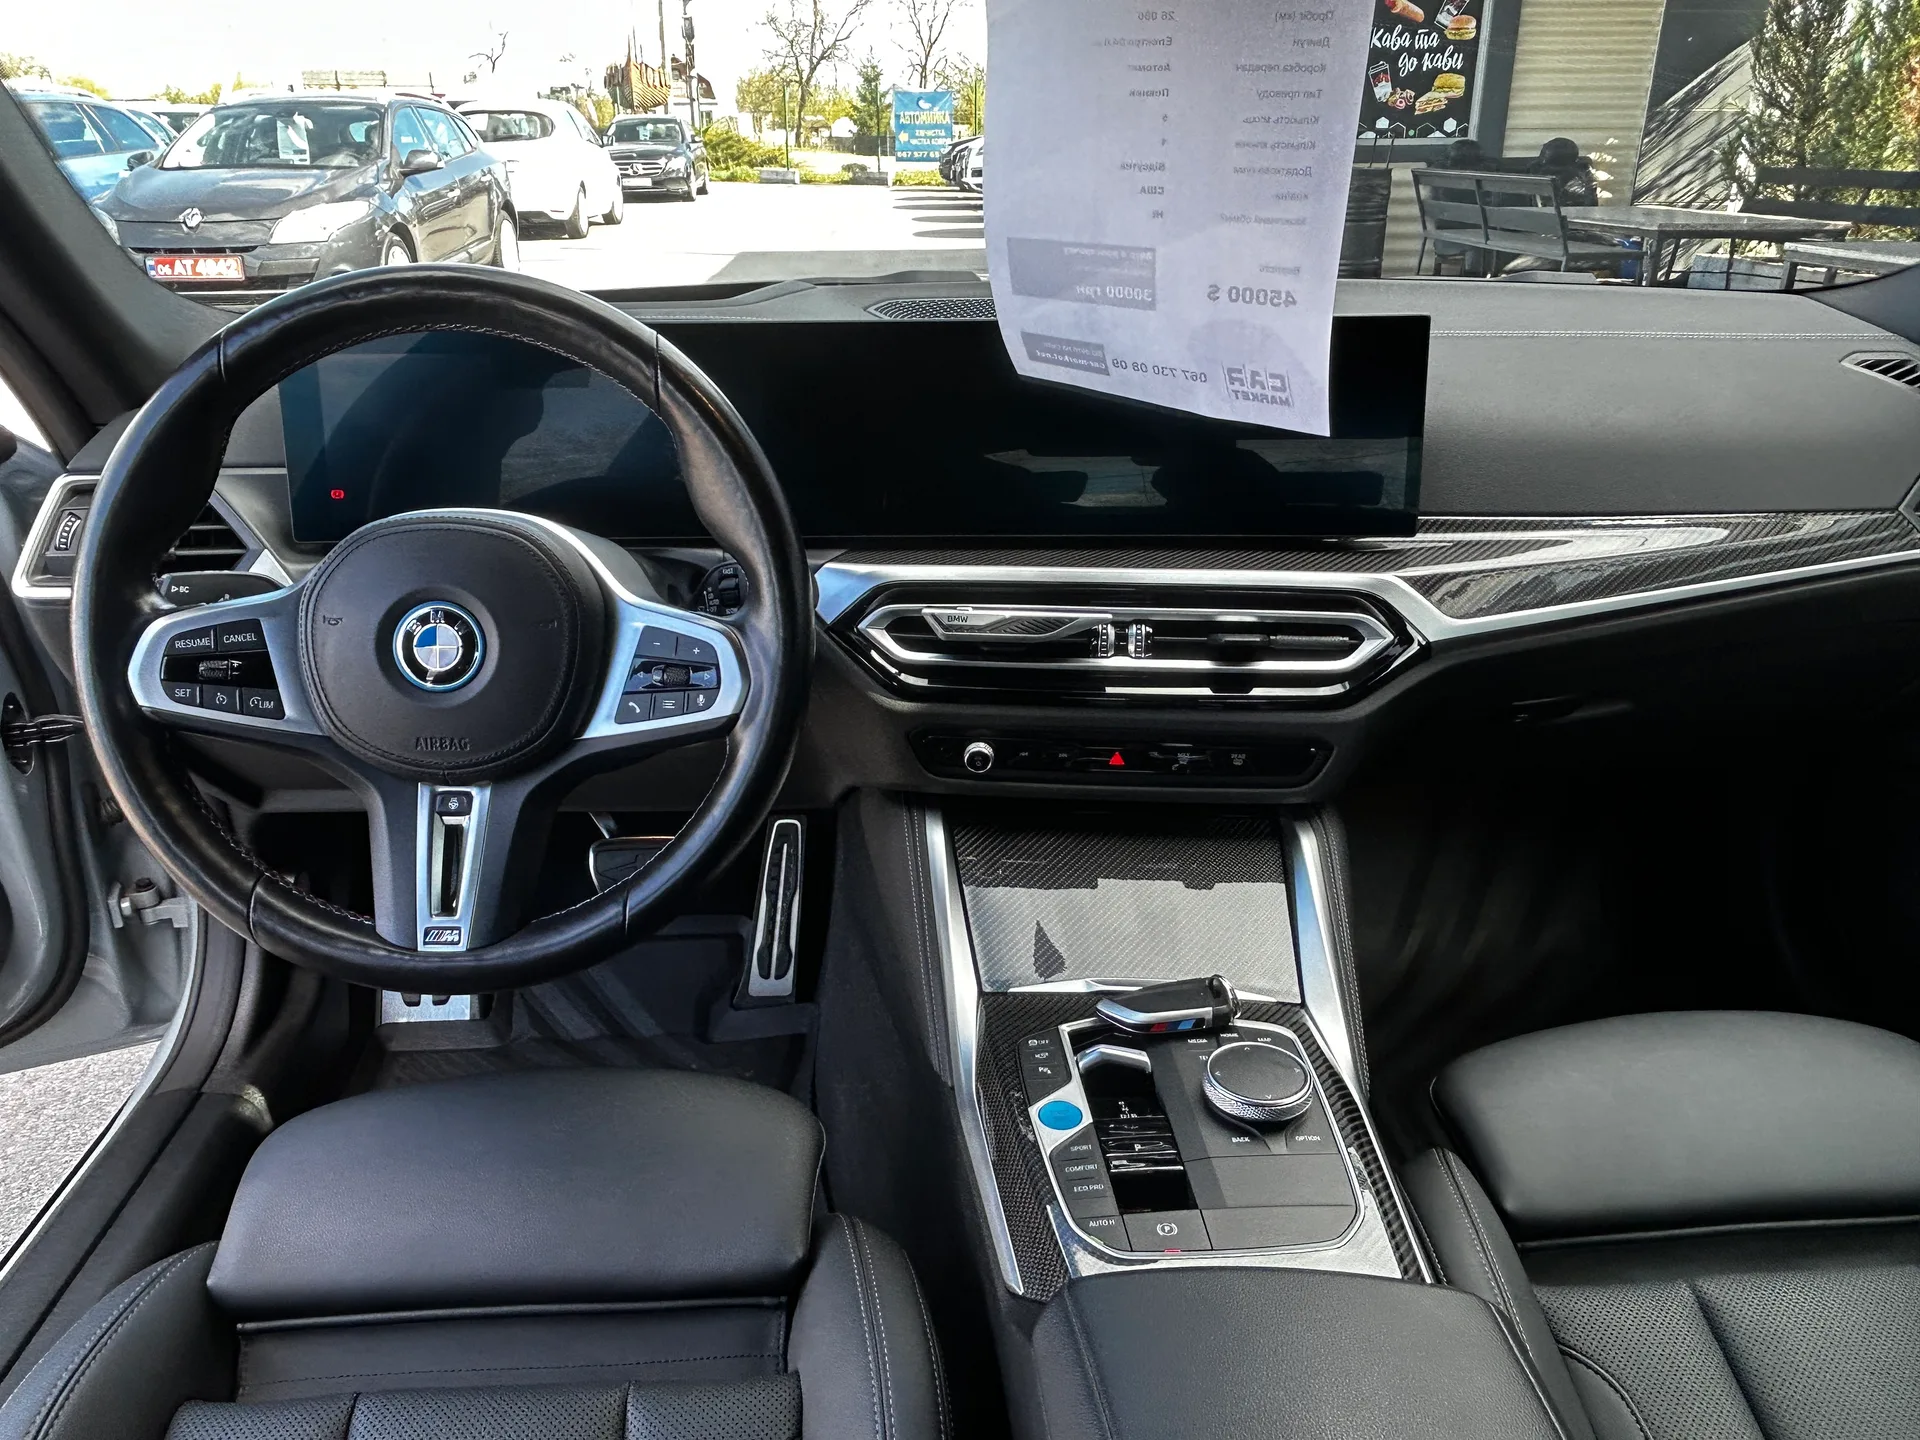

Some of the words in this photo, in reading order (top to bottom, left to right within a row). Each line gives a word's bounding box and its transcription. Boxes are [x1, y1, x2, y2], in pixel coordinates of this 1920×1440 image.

[1371, 24, 1412, 50] Кава
[1415, 29, 1440, 49] та
[1398, 52, 1418, 77] до
[1422, 45, 1463, 71] кави
[900, 108, 950, 124] АВТОМИЙКА
[173, 259, 194, 276] AT
[947, 615, 968, 623] BMW
[175, 637, 210, 648] RESUME
[224, 633, 257, 643] CANCEL
[175, 688, 191, 697] SET
[259, 700, 273, 709] LIM
[415, 736, 470, 751] AIRBAG
[1070, 1144, 1092, 1152] SPORT
[1065, 1163, 1098, 1173] COMFORT
